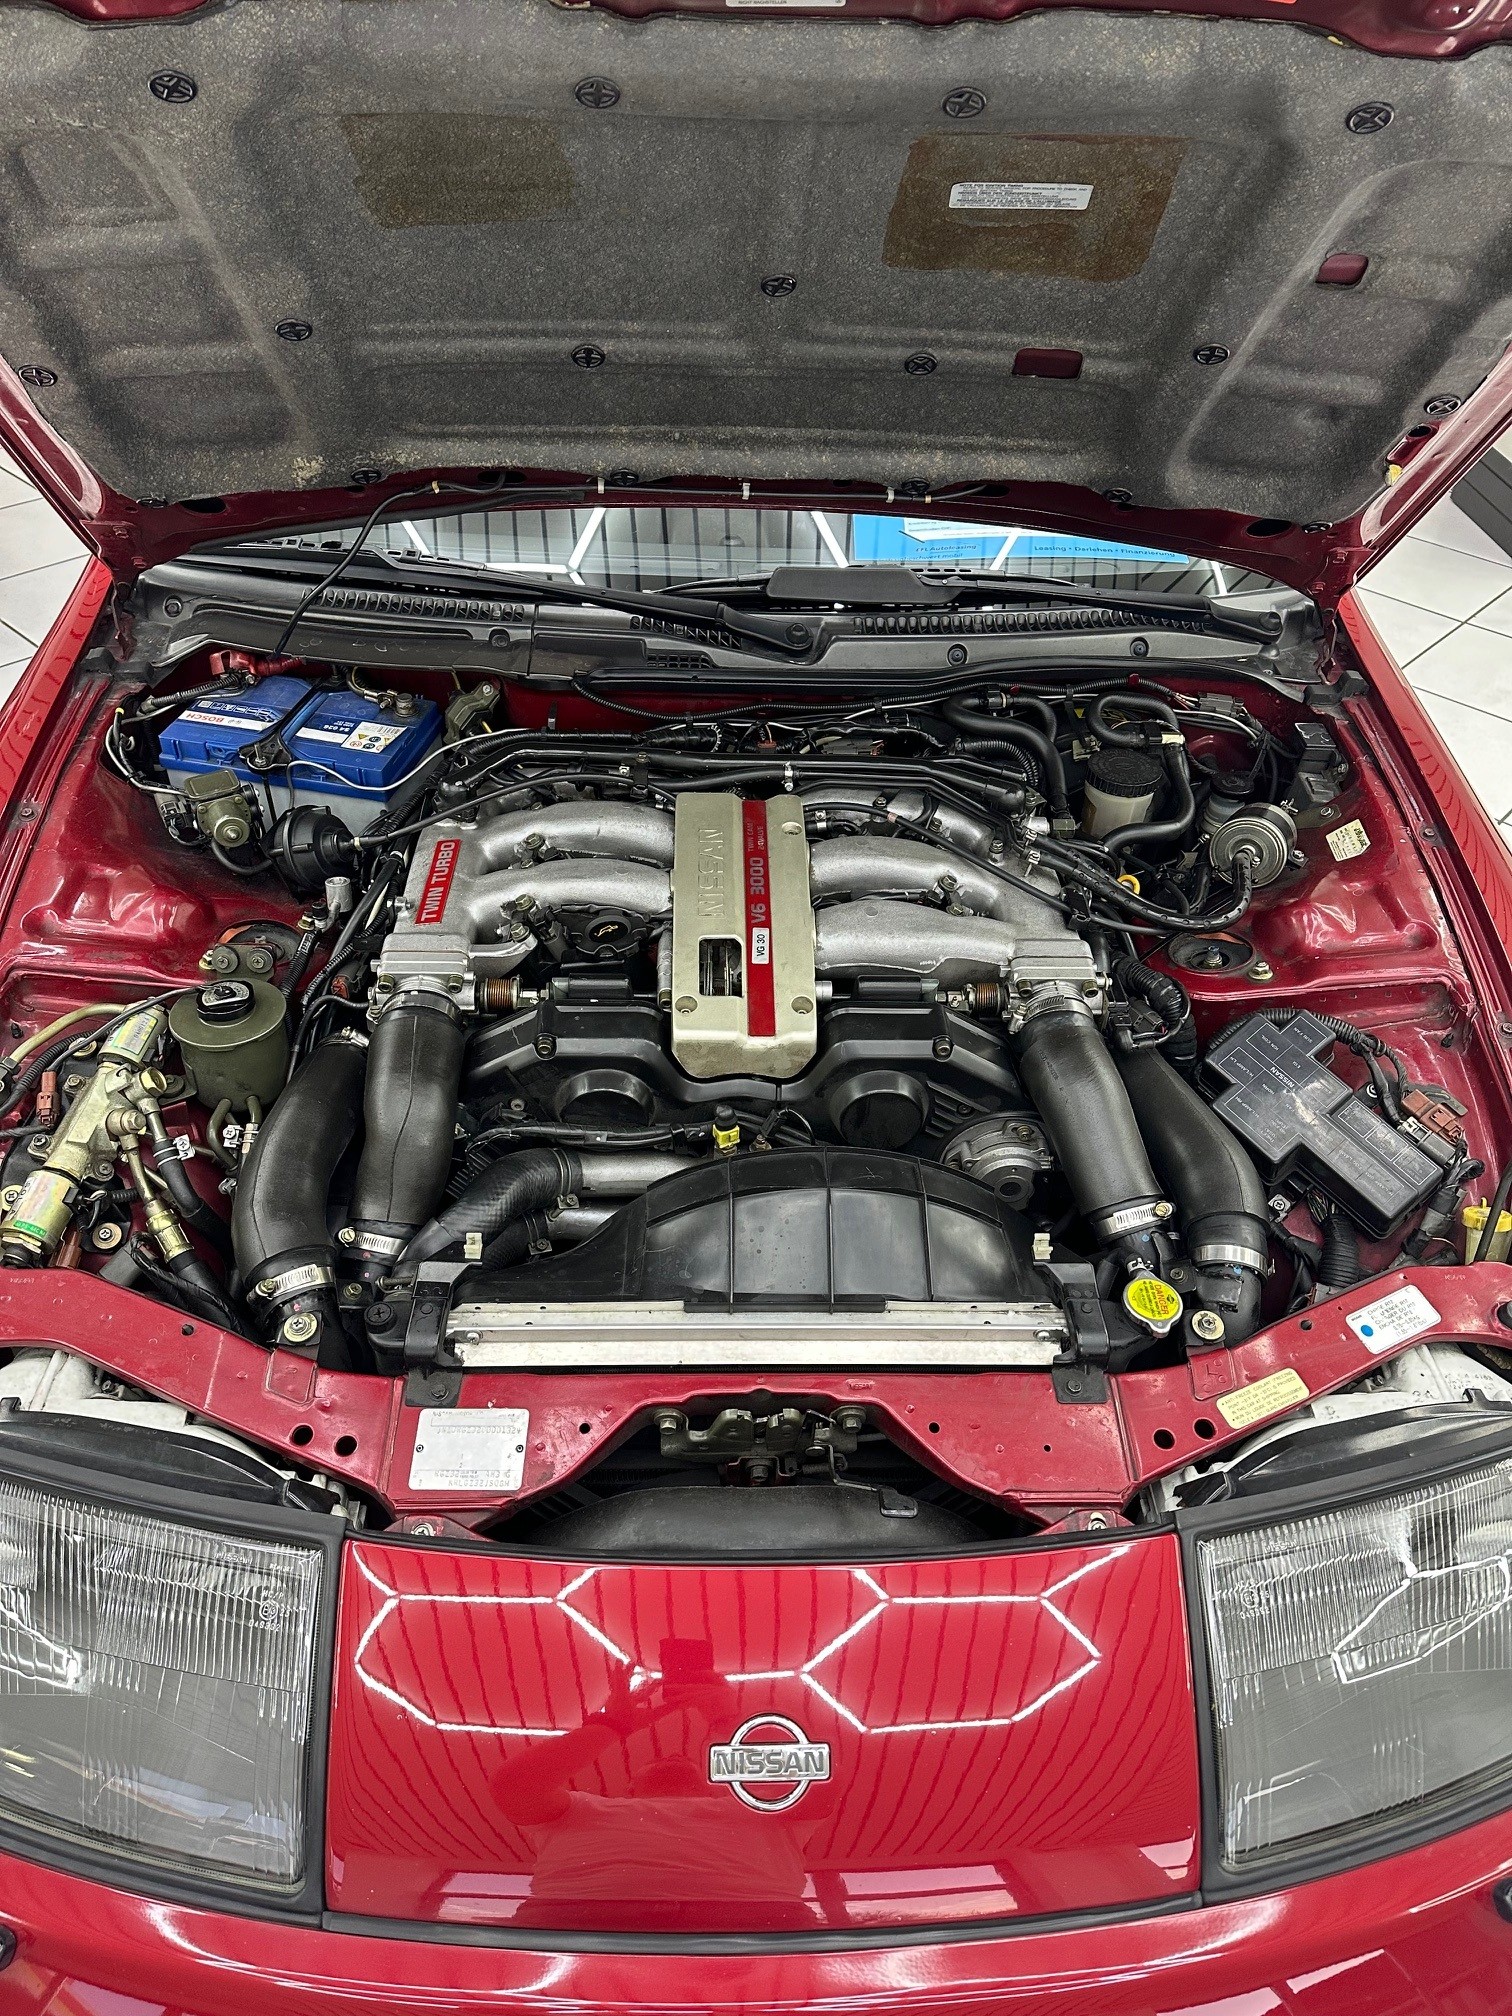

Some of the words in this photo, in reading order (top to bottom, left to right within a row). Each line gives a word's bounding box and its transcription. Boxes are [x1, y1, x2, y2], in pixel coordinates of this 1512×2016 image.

[1121, 549, 1175, 557] Finanzierung
[186, 712, 224, 723] BOSCH
[431, 841, 455, 884] TURBO
[698, 828, 724, 916] NISSAN
[750, 857, 765, 895] 3000
[421, 886, 444, 921] TWIN
[751, 903, 766, 924] V6
[756, 945, 765, 957] VG
[757, 934, 765, 945] 30
[1270, 1066, 1295, 1088] NISSAN
[1155, 1284, 1169, 1315] DANGER
[714, 1750, 824, 1776] NISSAN
